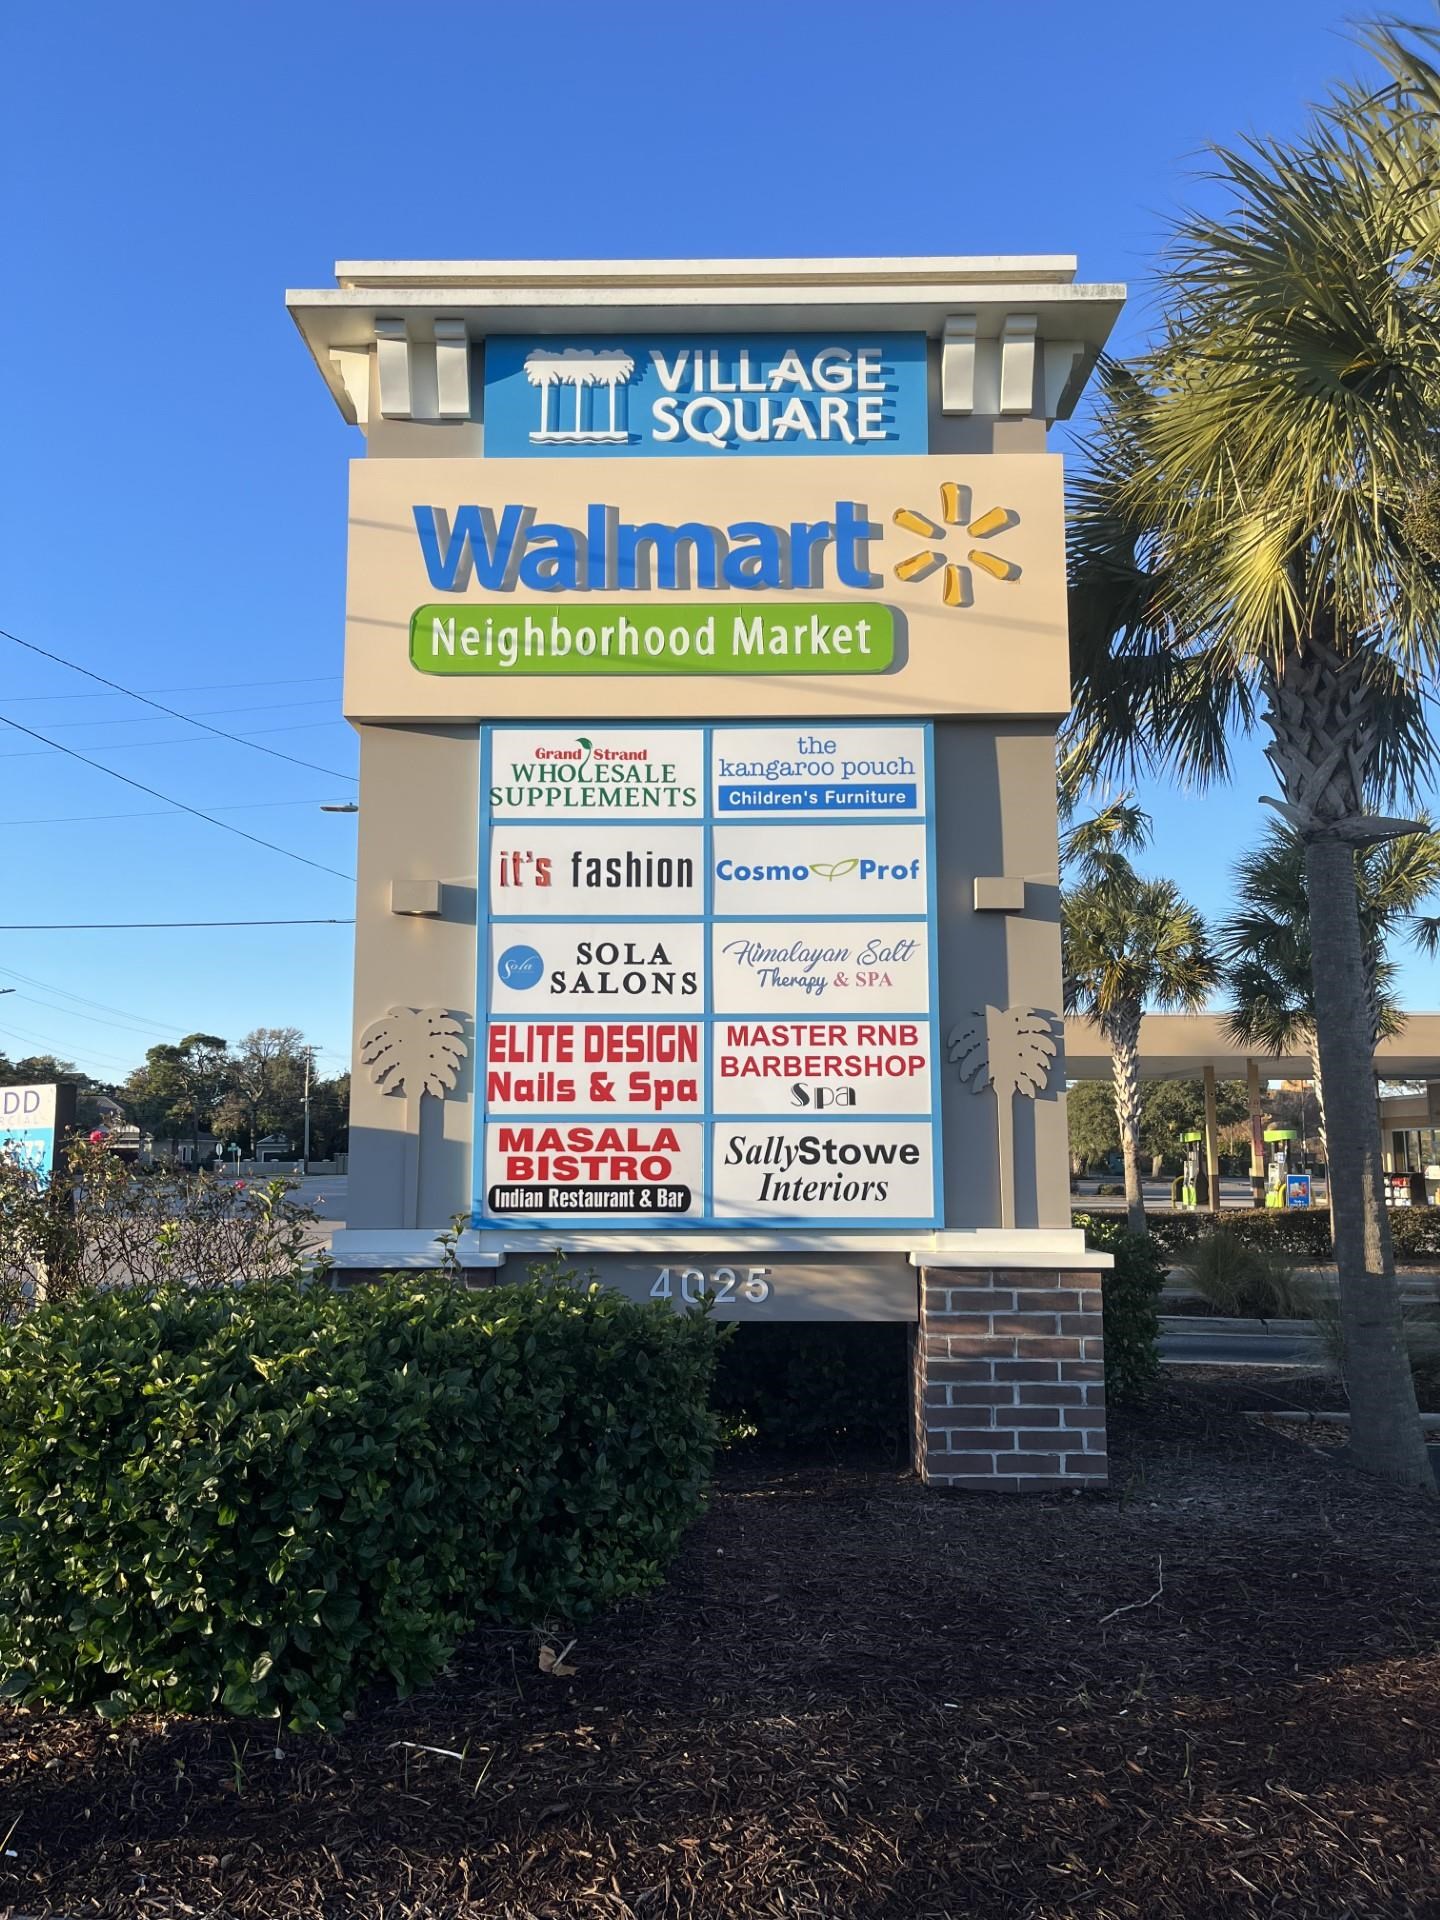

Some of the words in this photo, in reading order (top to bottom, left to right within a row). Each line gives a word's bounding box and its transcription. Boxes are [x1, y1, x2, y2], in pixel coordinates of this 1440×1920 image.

[649, 348, 886, 392] VILLAGE
[652, 396, 887, 448] SQUARE
[411, 501, 884, 592] Walmart
[432, 616, 715, 667] Neighborhood
[733, 615, 871, 656] Market
[535, 748, 582, 760] Grand
[593, 748, 647, 761] Strand
[797, 736, 836, 754] the
[511, 762, 676, 783] WHOLESALE
[719, 759, 834, 780] kangaroo
[841, 757, 915, 780] pouch
[490, 787, 696, 807] SUPPLEMENTS
[729, 790, 818, 806] Children's
[825, 790, 906, 804] Furniture
[499, 850, 551, 888] it's
[572, 851, 694, 888] fashion
[716, 860, 809, 881] Cosmo
[859, 859, 919, 880] Prof
[576, 942, 672, 965] SOLA
[722, 940, 852, 972] Himalayan
[856, 938, 921, 963] Salt
[501, 956, 540, 980] Sola
[550, 971, 697, 994] SALONS
[757, 969, 828, 994] Therapy
[834, 972, 848, 988] &
[856, 972, 892, 987] SPA
[489, 1025, 574, 1063] ELITE
[584, 1025, 698, 1063] DESIGN
[727, 1025, 846, 1047] MASTER
[857, 1025, 918, 1046] RNB
[720, 1056, 926, 1077] BARBERSHOP
[487, 1072, 575, 1102] Nails
[590, 1072, 616, 1102] &
[629, 1071, 698, 1110] Spa
[791, 1083, 856, 1110] Spa
[499, 1128, 680, 1152] MASALA
[506, 1156, 672, 1182] BISTRO
[495, 1189, 543, 1209] Indian
[548, 1188, 634, 1208] Restaurant
[640, 1189, 652, 1207] &
[657, 1189, 684, 1208] Bar
[757, 1172, 888, 1202] Interiors
[650, 1267, 769, 1303] 4025
